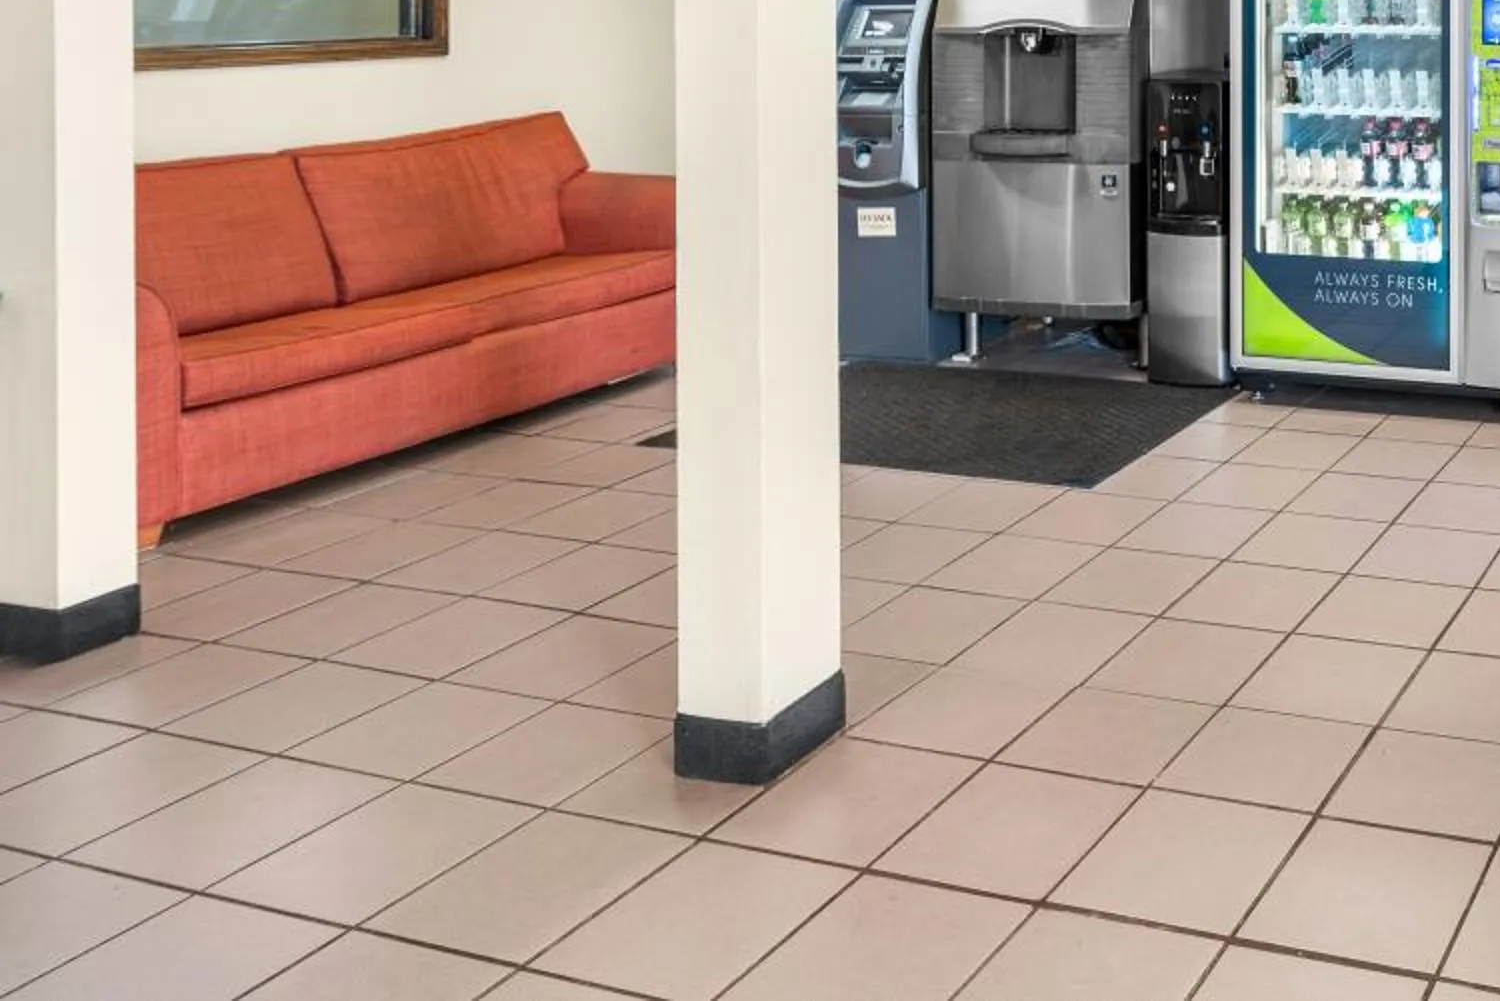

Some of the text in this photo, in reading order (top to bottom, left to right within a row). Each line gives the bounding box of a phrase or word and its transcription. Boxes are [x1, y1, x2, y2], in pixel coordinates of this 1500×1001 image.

[1314, 270, 1380, 288] ALWAYS
[1314, 288, 1413, 308] ALWAYS ON
